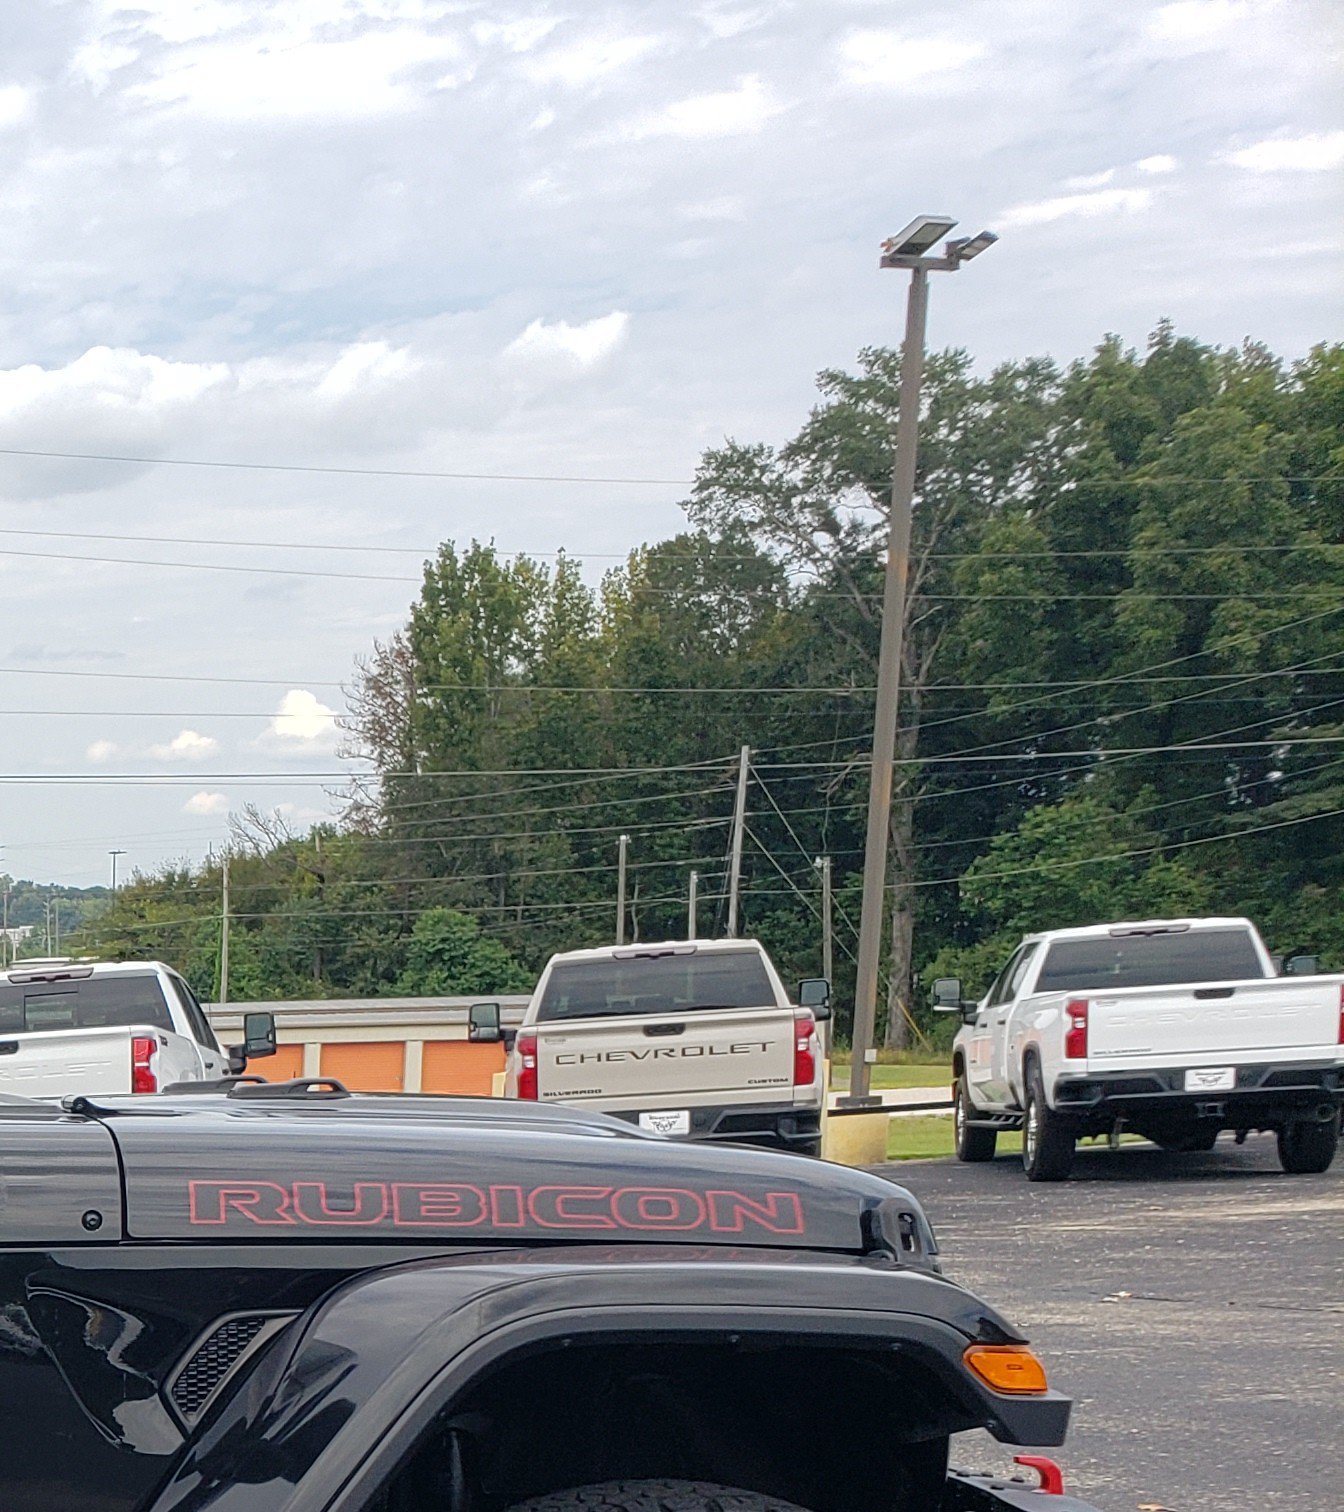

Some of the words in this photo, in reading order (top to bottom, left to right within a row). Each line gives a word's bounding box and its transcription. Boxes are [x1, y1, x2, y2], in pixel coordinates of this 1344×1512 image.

[555, 1041, 776, 1066] CHEVROLET
[542, 1088, 602, 1097] SILVERADO
[188, 1180, 805, 1234] RUBICON
